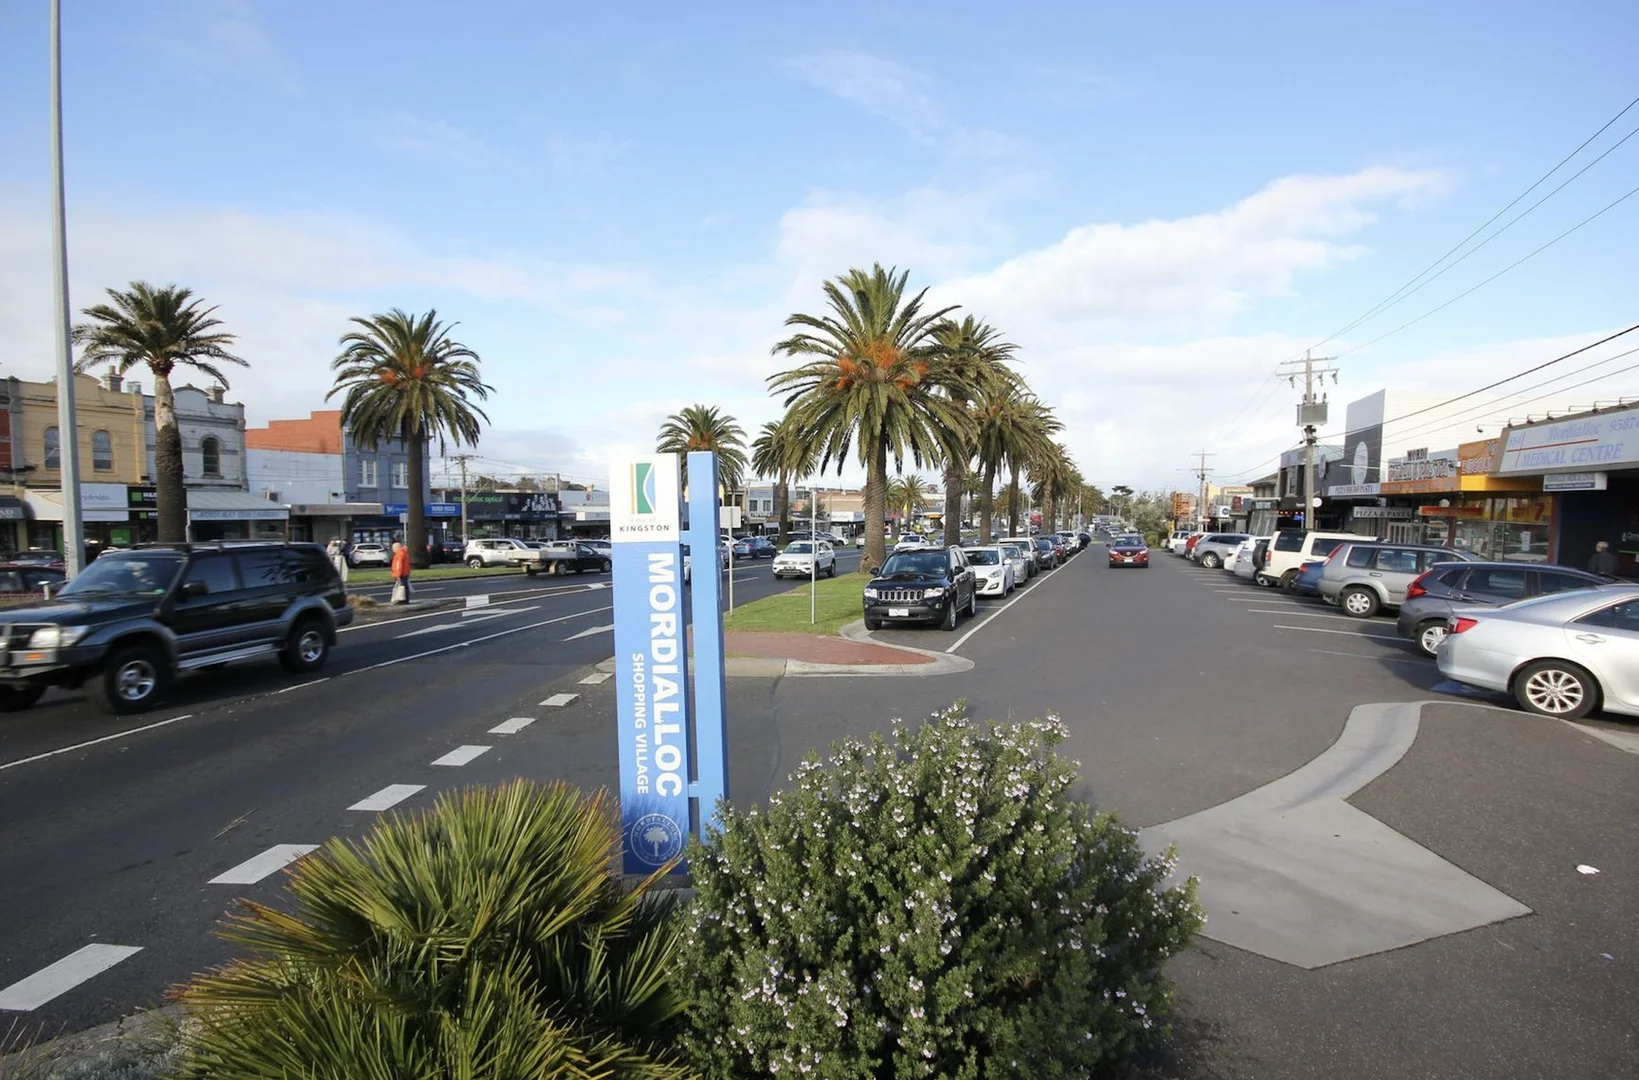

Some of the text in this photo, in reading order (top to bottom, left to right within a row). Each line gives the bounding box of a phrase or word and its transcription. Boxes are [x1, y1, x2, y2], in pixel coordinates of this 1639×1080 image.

[1521, 443, 1624, 467] MEDICAL CENTRE
[632, 652, 649, 794] SHOPPING VILLAGE
[648, 553, 682, 797] MORDIALLOC
